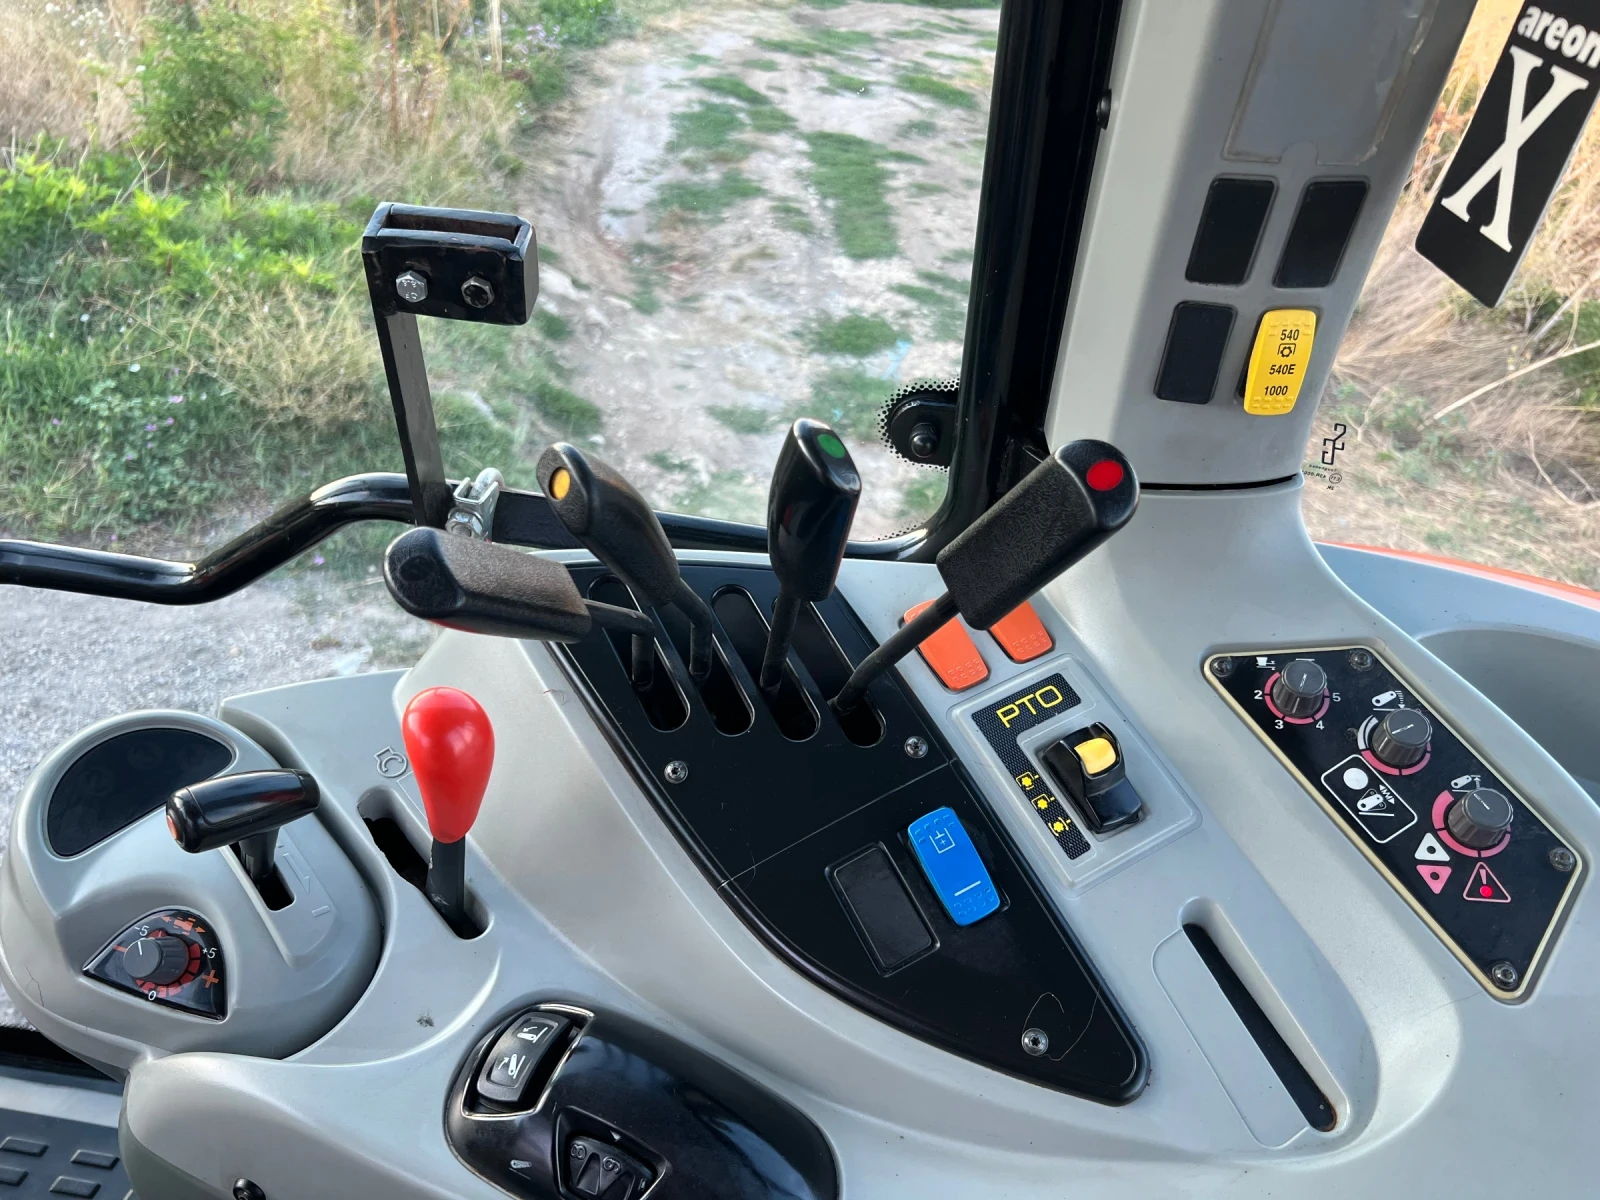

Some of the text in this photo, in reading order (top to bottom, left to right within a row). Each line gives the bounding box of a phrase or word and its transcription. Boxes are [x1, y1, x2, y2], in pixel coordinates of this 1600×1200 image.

[1517, 5, 1600, 69] areon
[1441, 45, 1589, 253] X
[1280, 329, 1299, 341] 540
[1269, 364, 1296, 376] 540E
[1264, 385, 1288, 396] 1000
[1254, 690, 1263, 700] 2
[1332, 692, 1341, 702] 5
[996, 685, 1063, 728] PTO
[1275, 720, 1284, 729] 3
[1316, 721, 1325, 730] 4
[202, 947, 217, 959] +5
[148, 990, 156, 1000] 0
